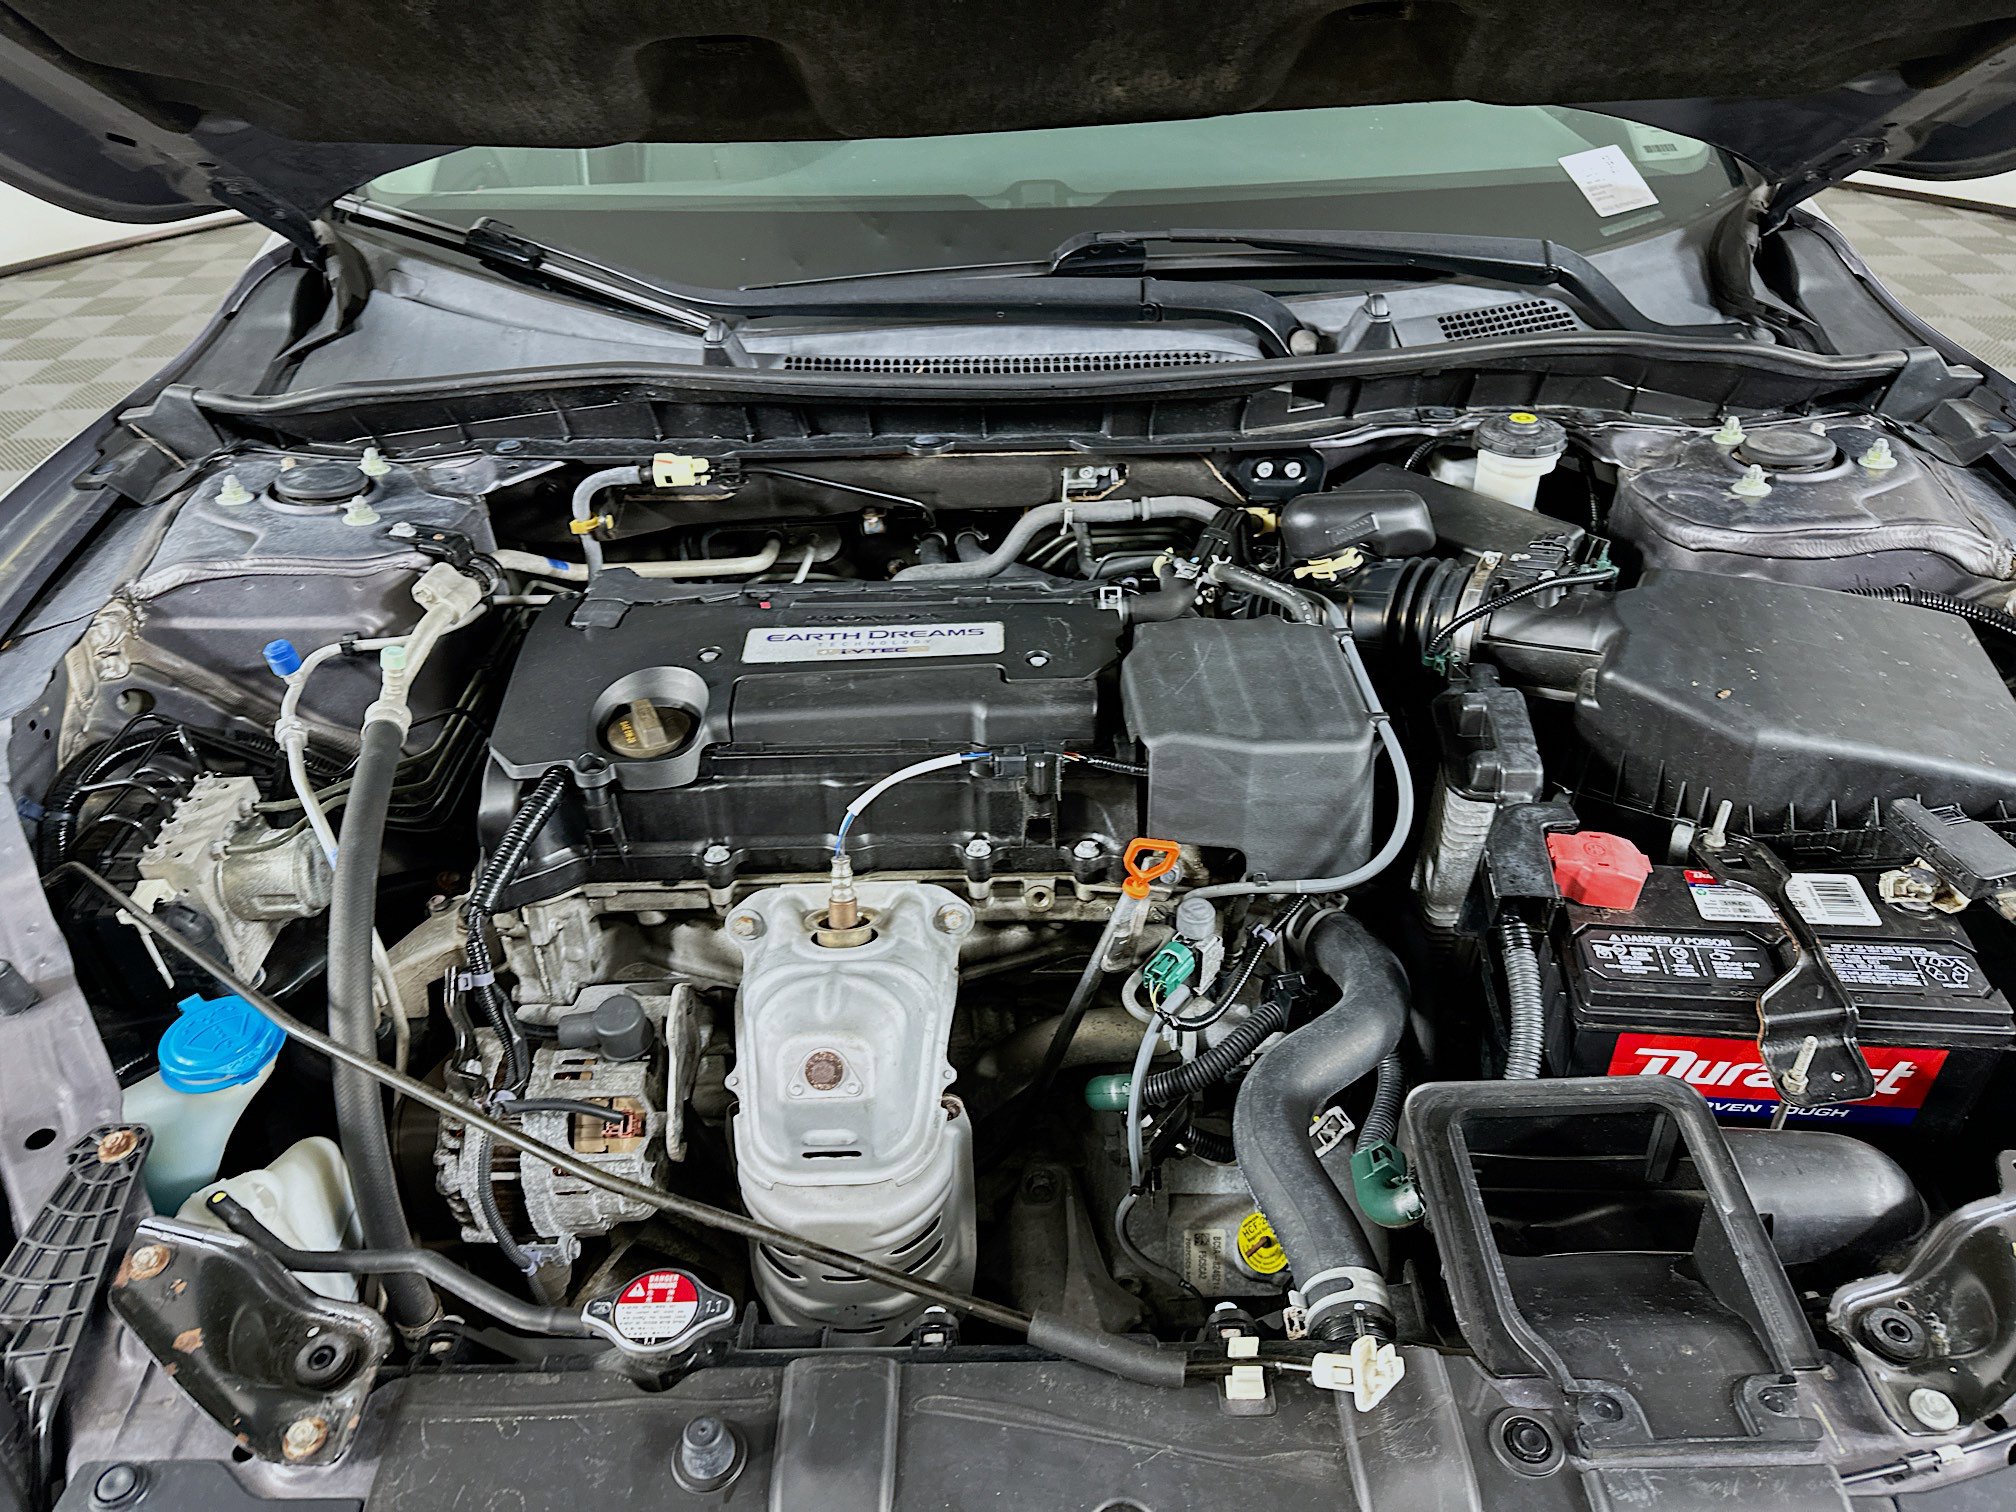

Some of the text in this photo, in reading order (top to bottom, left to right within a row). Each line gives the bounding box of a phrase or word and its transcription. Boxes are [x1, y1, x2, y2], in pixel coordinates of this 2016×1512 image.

[766, 628, 985, 643] EARTH DREAMS
[817, 638, 933, 648] TECHNOLOGY
[1620, 934, 1672, 945] DANGER
[1683, 936, 1732, 947] POISON
[705, 1299, 722, 1314] 1.1
